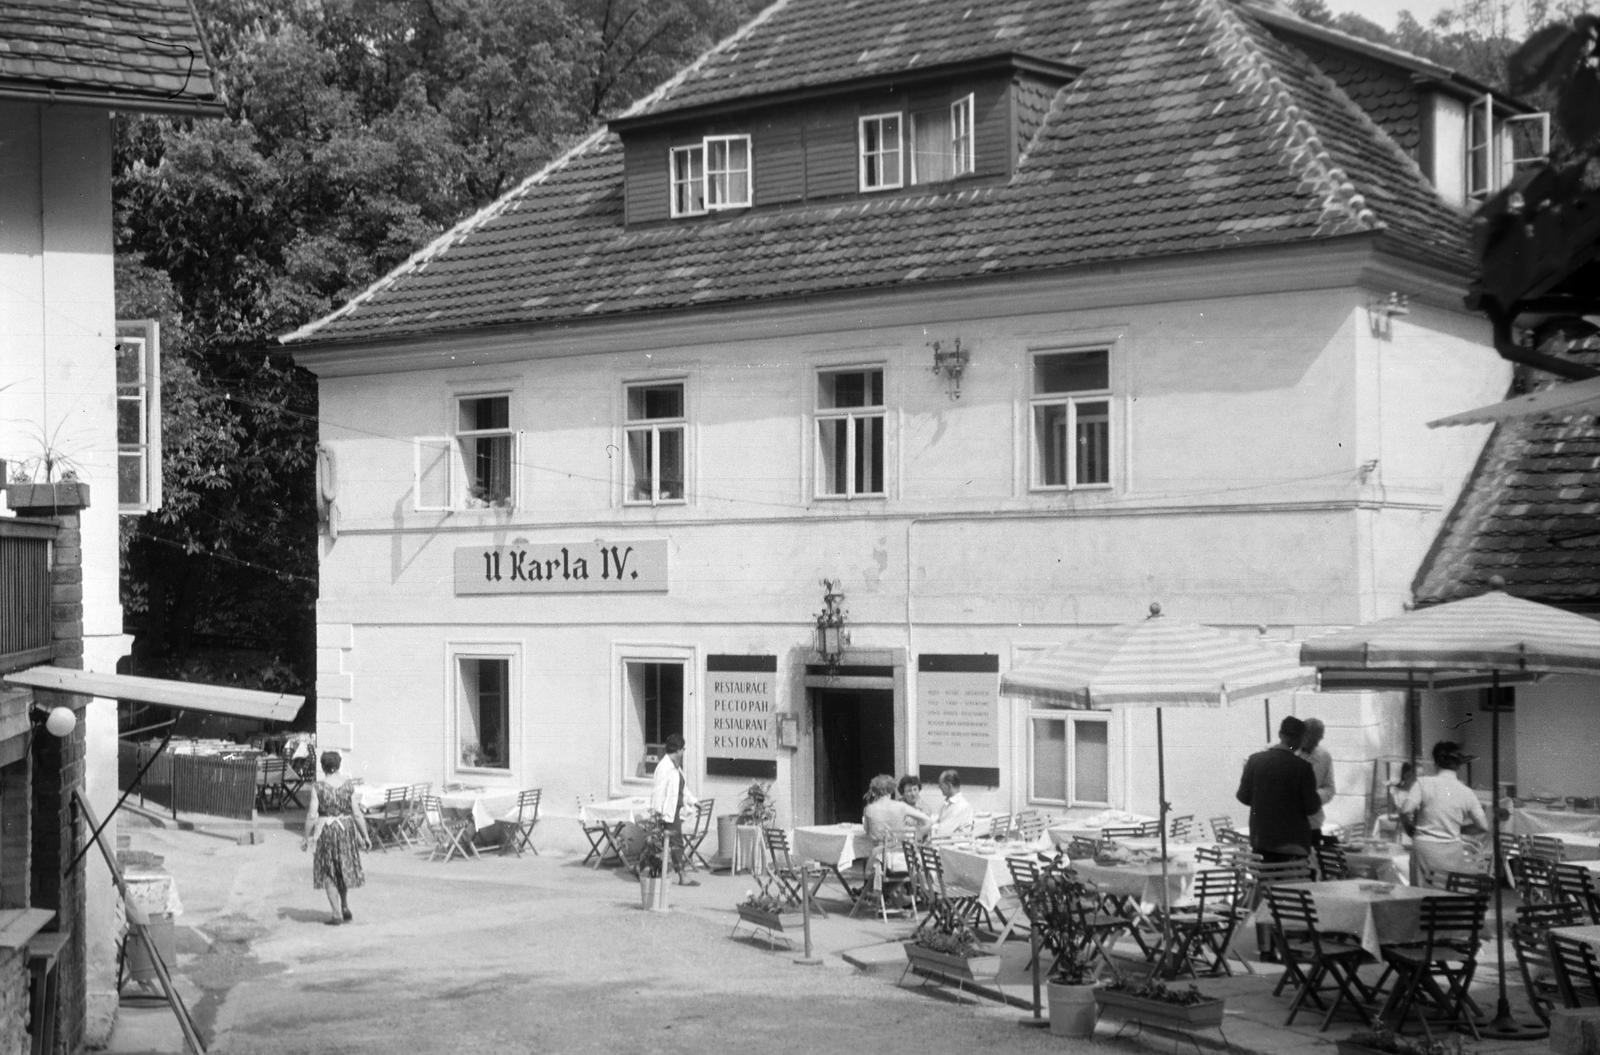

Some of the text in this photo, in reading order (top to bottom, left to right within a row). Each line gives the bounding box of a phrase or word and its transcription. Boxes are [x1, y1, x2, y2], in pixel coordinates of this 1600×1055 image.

[509, 547, 589, 581] Karla
[601, 546, 638, 580] IV.
[714, 681, 768, 694] RESTAURACE
[714, 718, 768, 731] RESTAURANT
